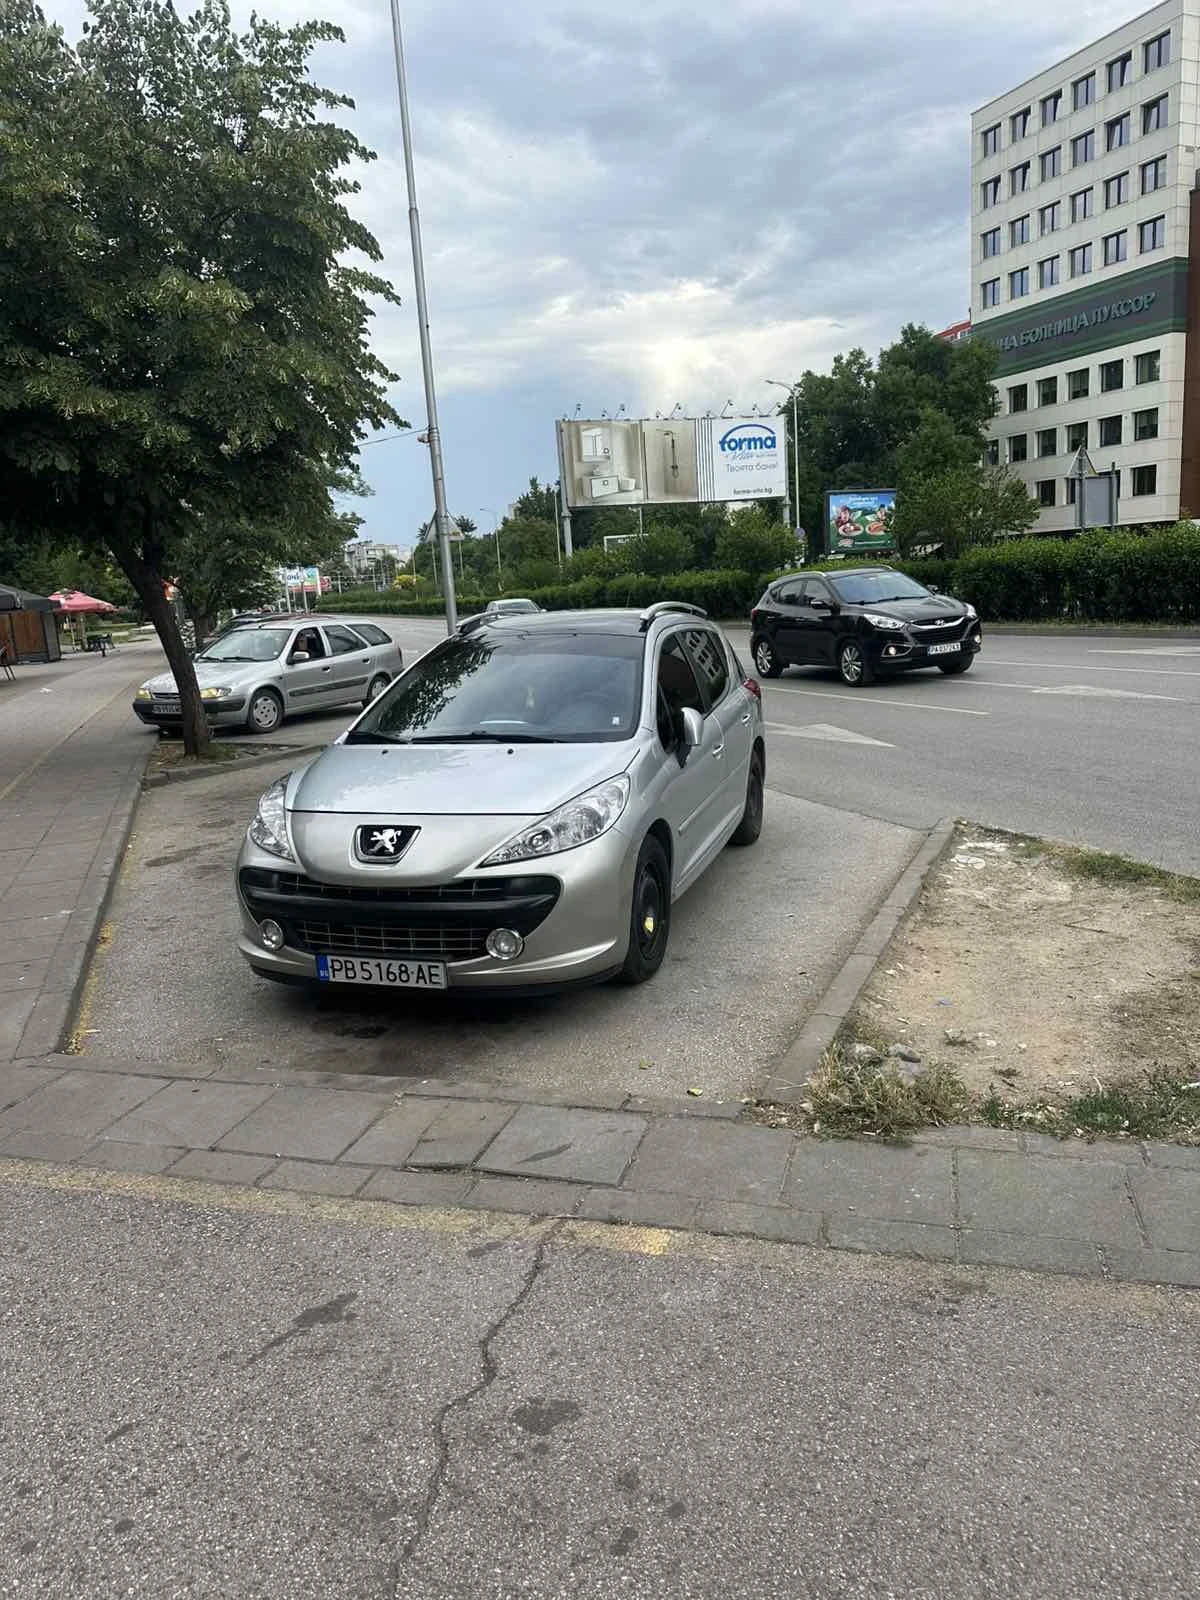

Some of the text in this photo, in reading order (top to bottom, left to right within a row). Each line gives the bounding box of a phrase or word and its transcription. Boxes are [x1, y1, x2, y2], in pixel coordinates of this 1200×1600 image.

[1020, 311, 1090, 349] БОЛНИЦА
[1089, 291, 1157, 327] ЛУКСОР
[719, 423, 777, 452] forma
